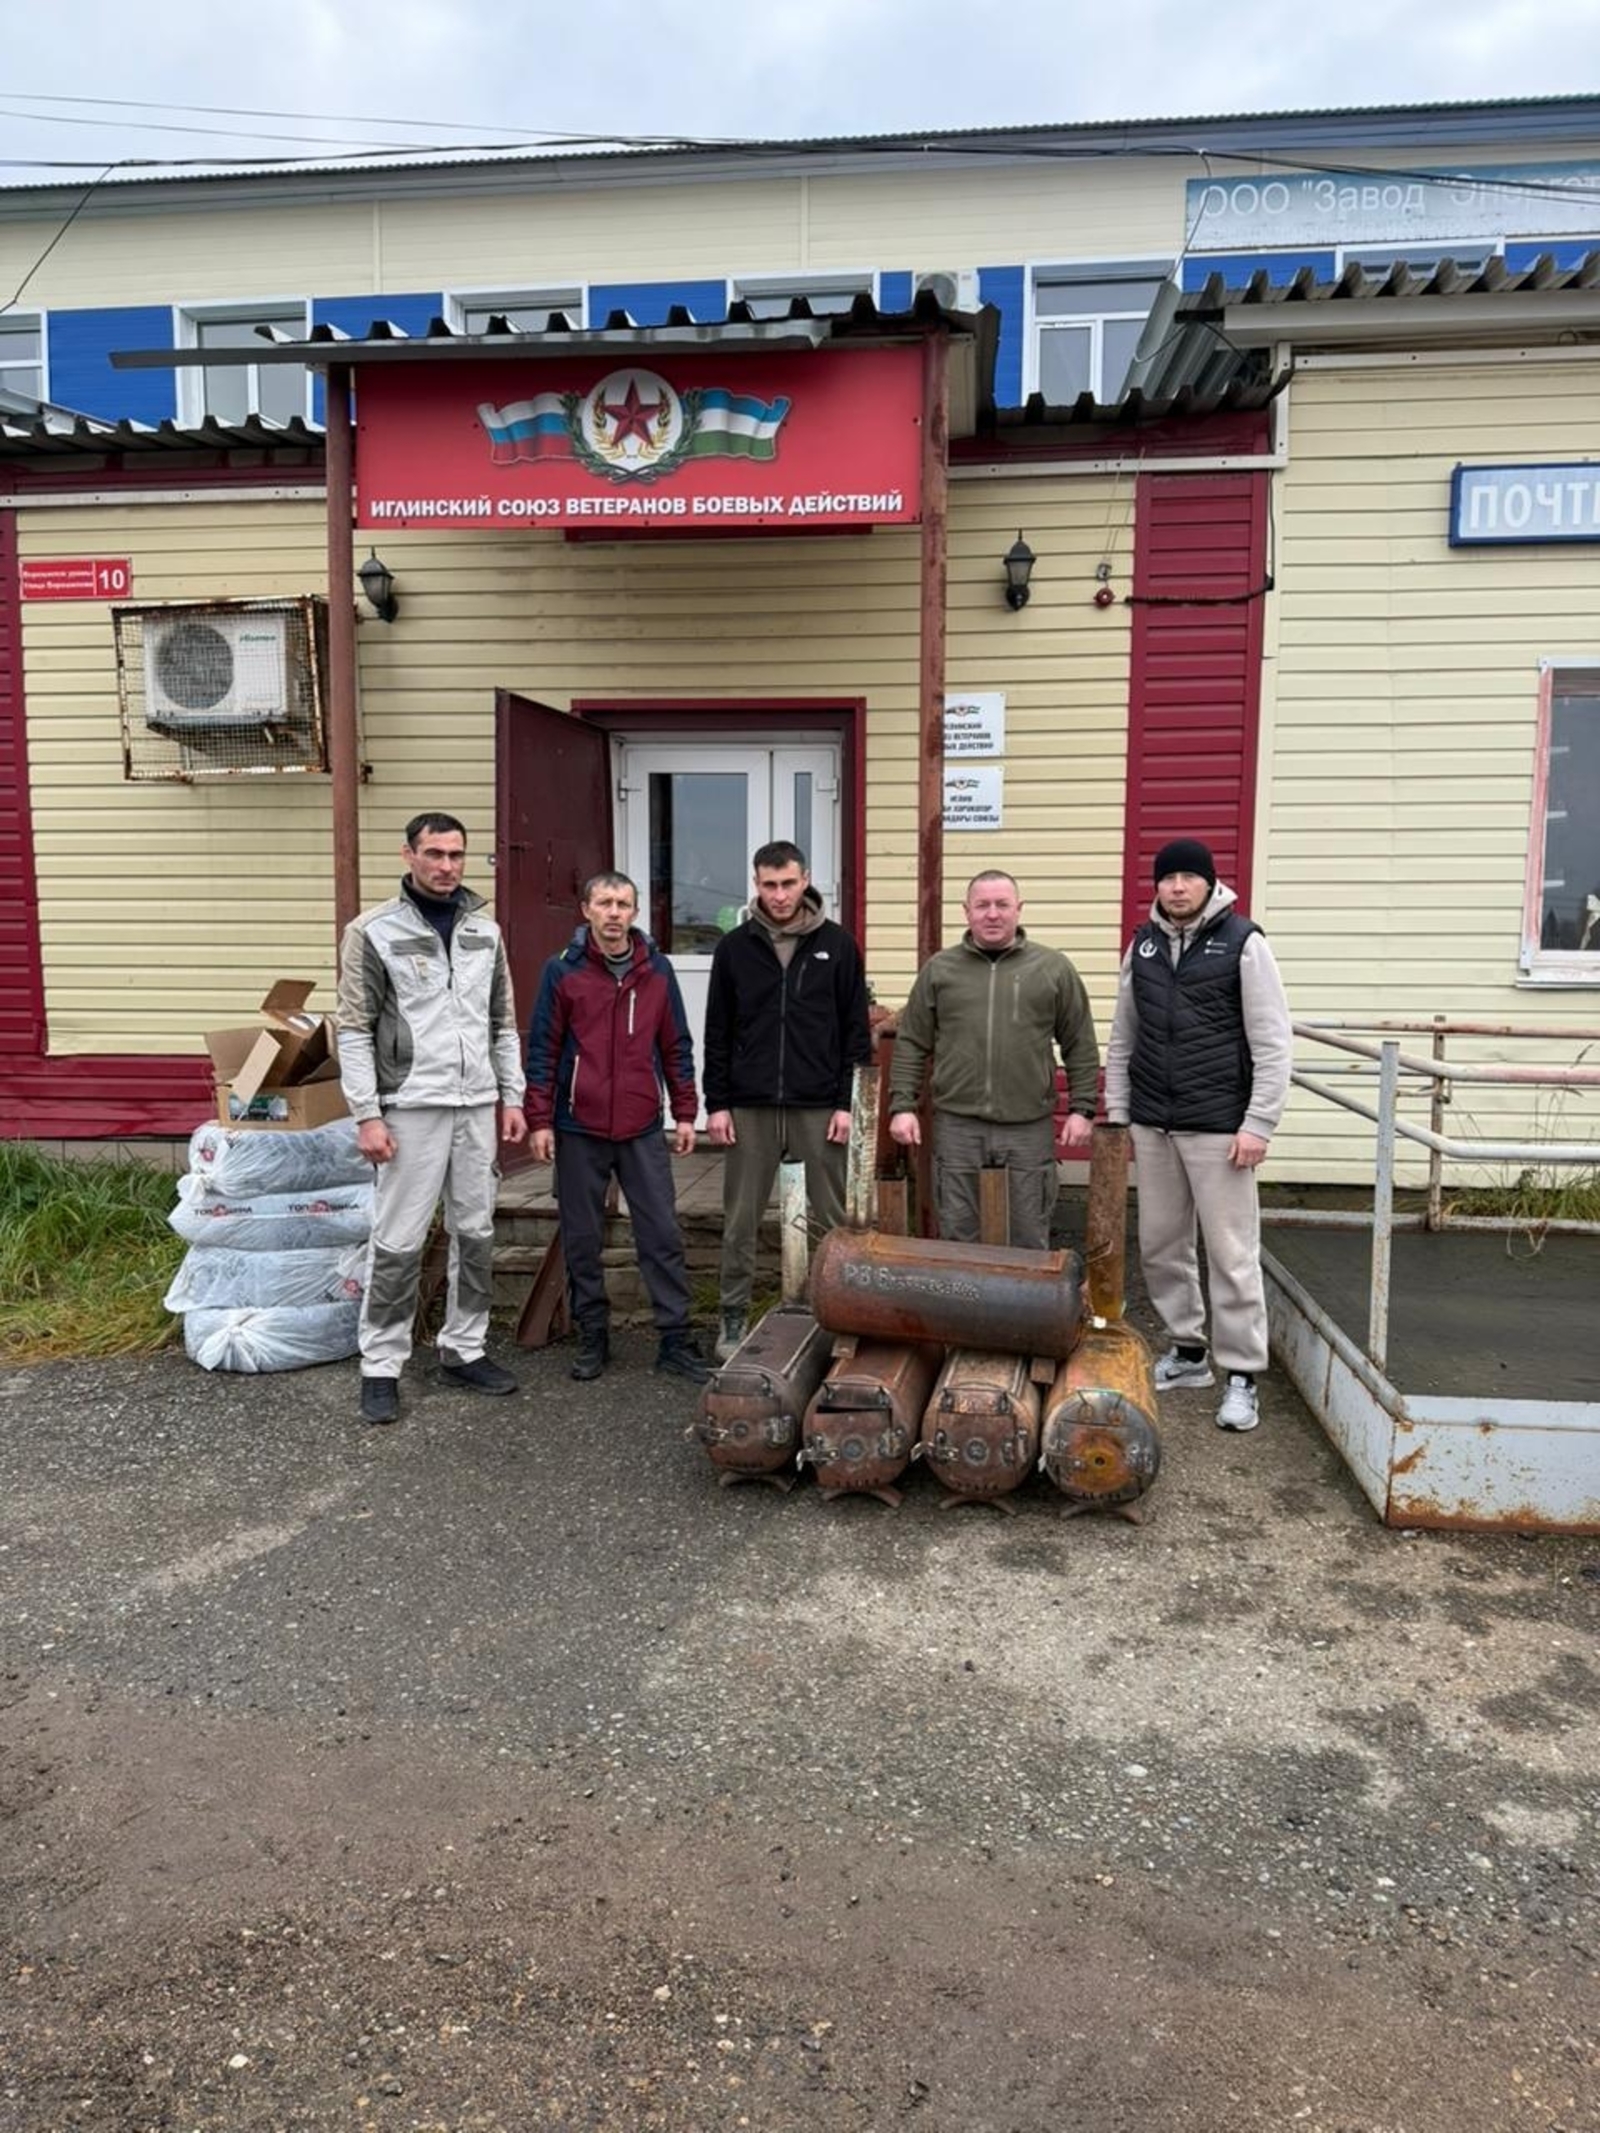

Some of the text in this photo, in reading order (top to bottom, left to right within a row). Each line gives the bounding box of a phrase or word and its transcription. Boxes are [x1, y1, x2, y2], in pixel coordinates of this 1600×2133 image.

[1199, 182, 1290, 216] ООО
[1301, 179, 1426, 217] "Завод
[371, 489, 903, 517] ИГЛИНСКИЙ СОЮЗ ВЕТЕРАНОВ БОЕВЫХ ДЕЙСТВИЙ
[99, 569, 125, 589] 10
